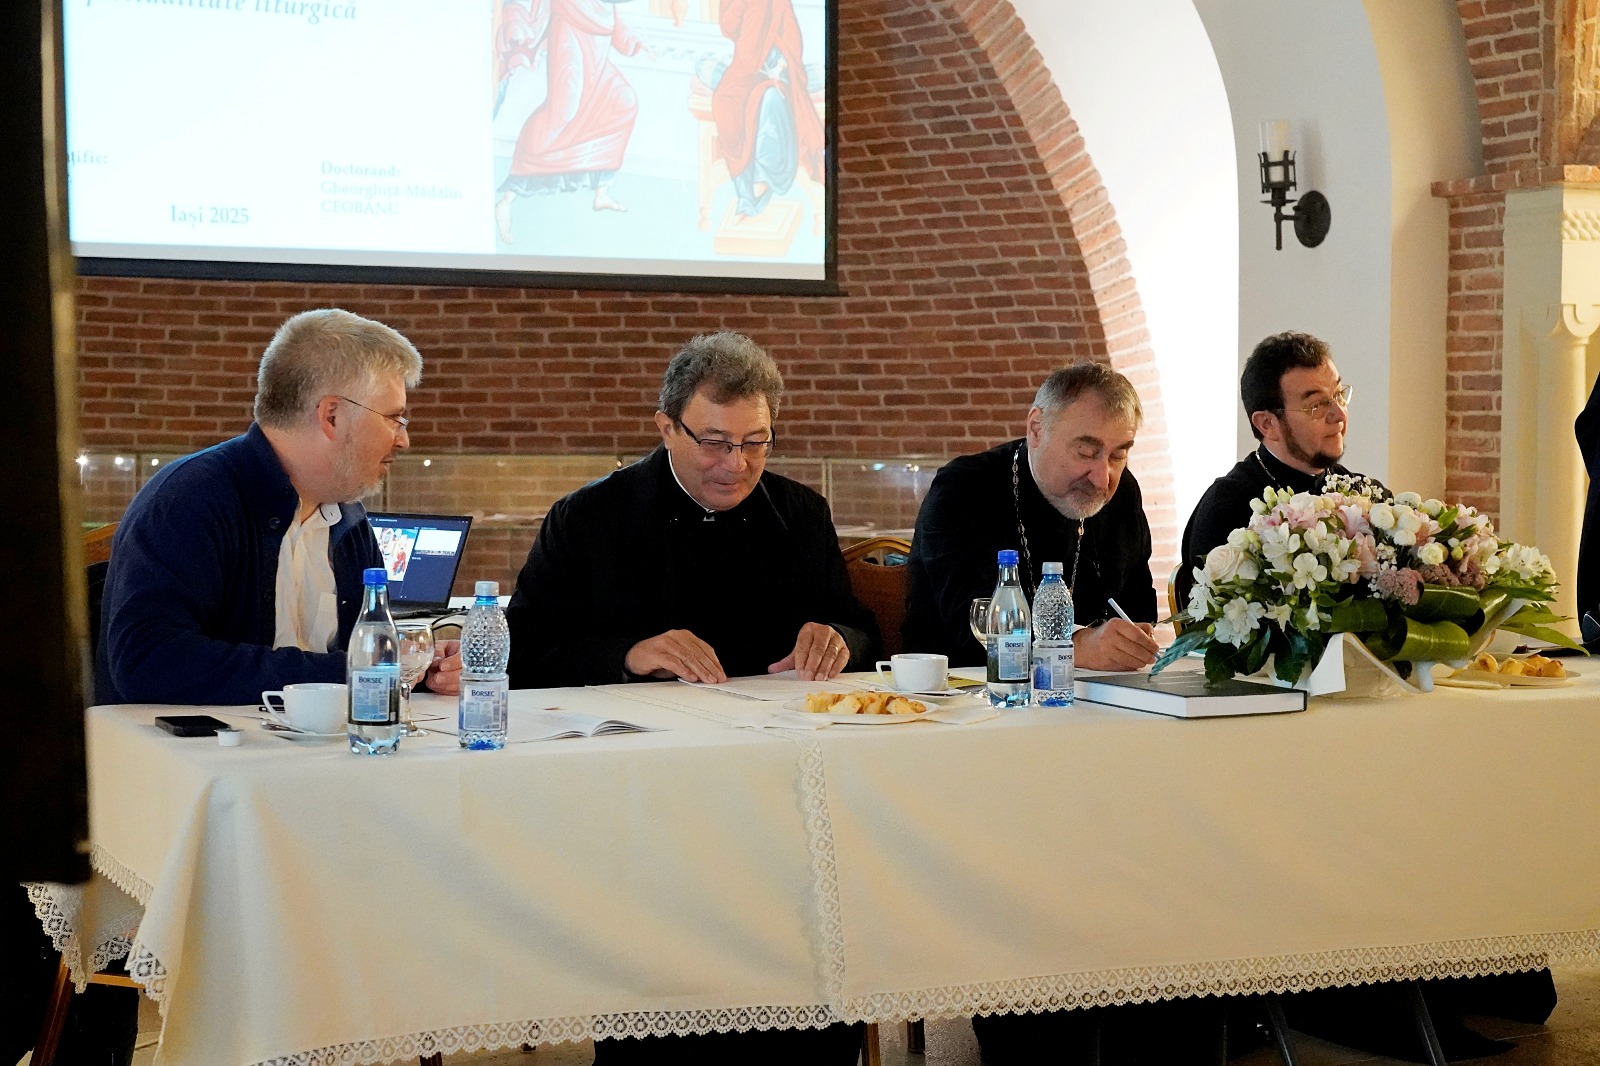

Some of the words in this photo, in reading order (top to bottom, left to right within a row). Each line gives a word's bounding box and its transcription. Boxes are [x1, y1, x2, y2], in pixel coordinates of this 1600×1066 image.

[320, 160, 401, 177] Doctorand:
[170, 204, 203, 227] Iași
[209, 206, 250, 224] 2025
[358, 676, 383, 684] BORSEC
[471, 689, 495, 697] BORSEC
